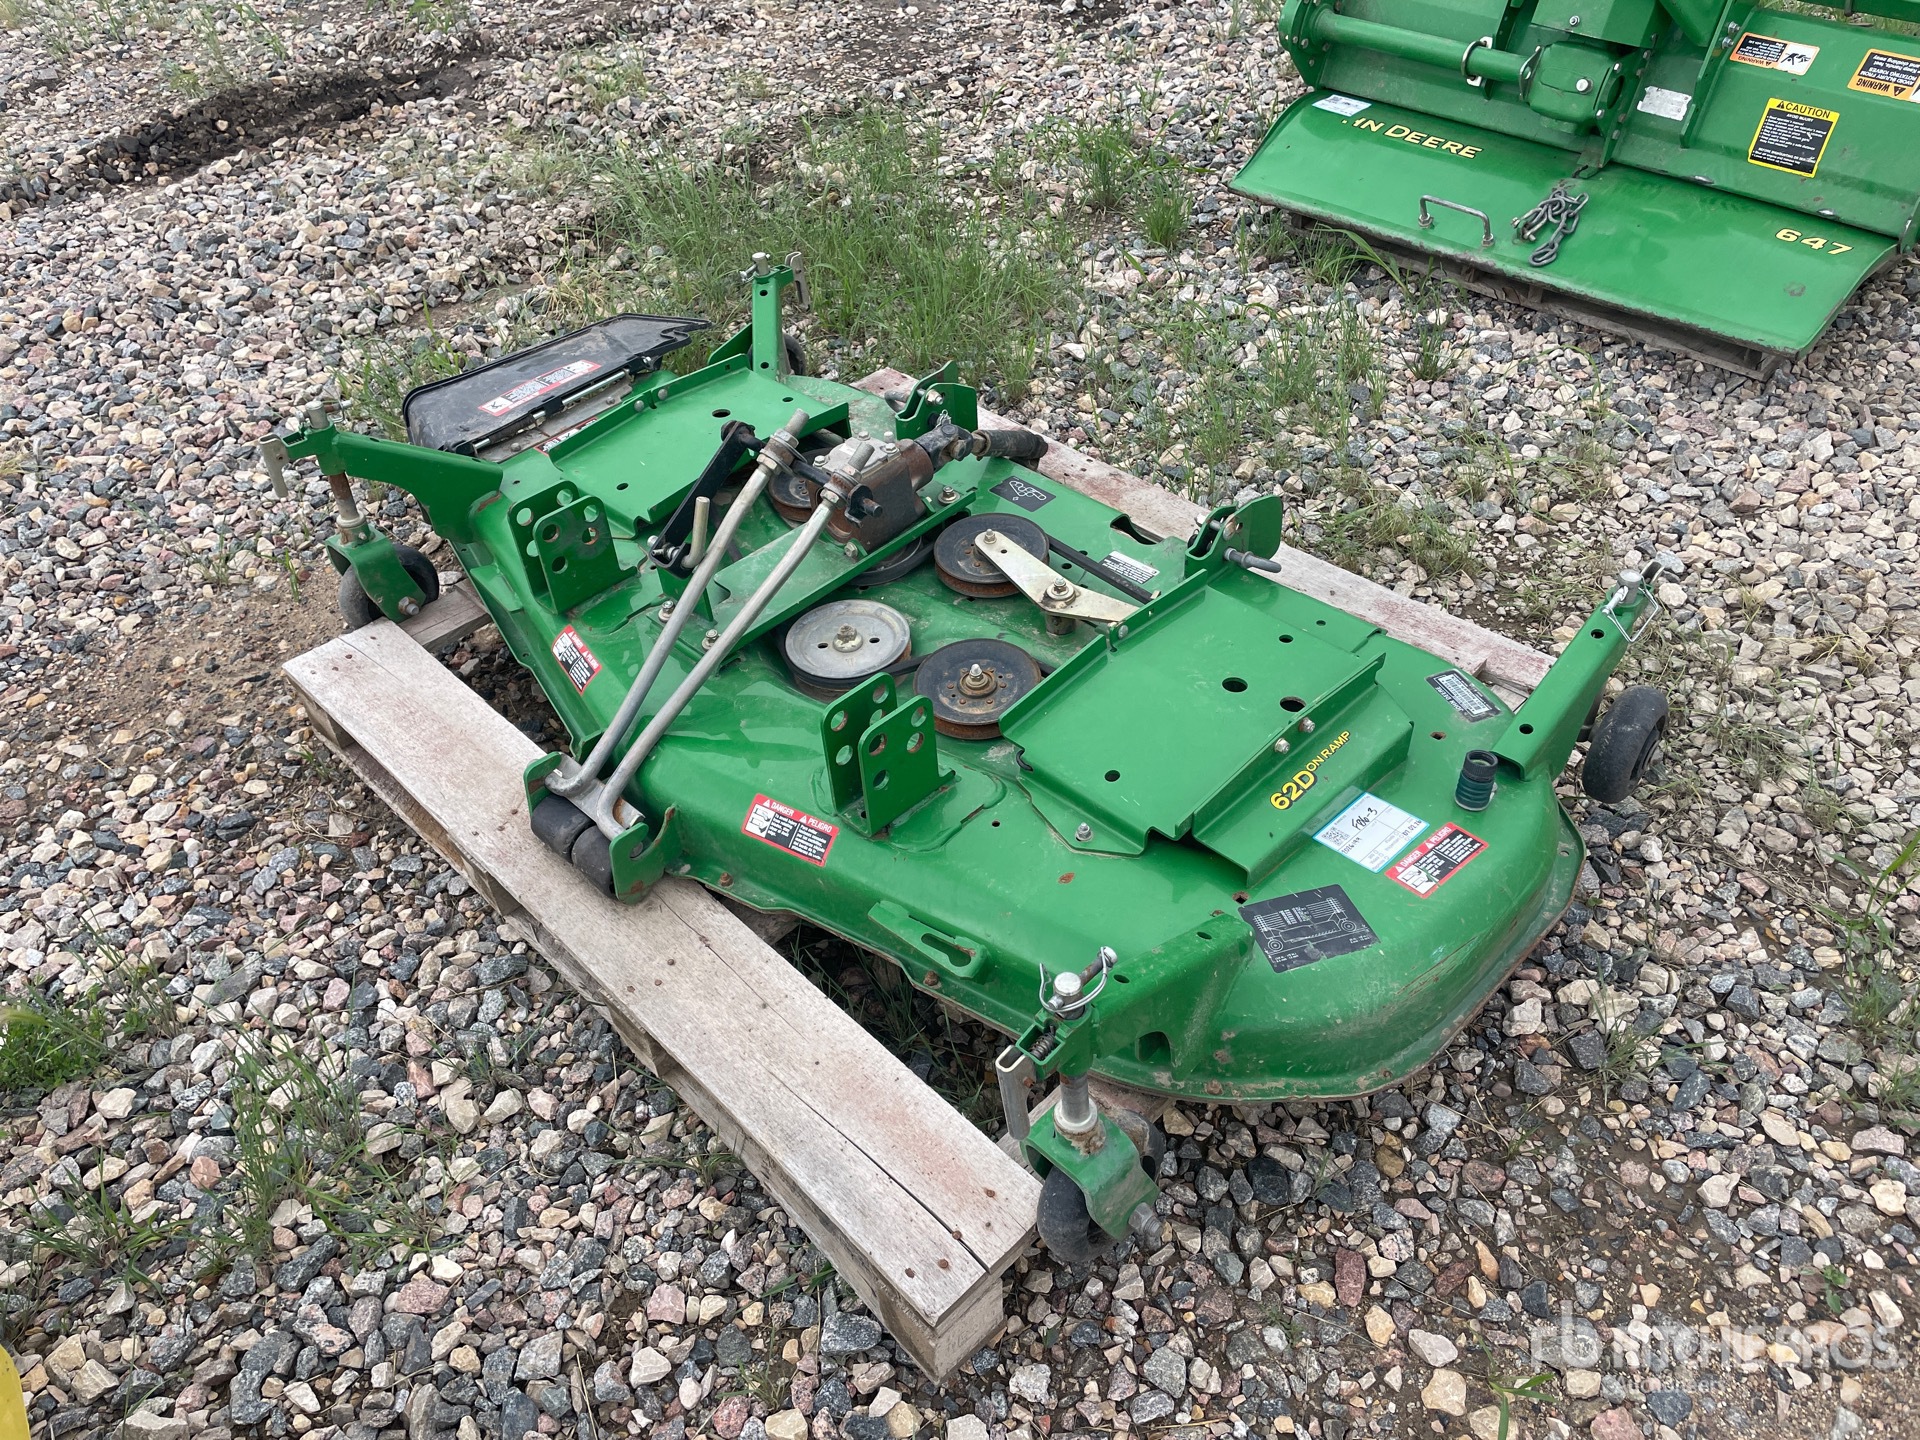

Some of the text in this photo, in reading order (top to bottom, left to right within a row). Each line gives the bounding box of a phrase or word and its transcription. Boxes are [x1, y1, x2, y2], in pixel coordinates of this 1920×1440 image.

[1738, 55, 1765, 65] WARNING
[1868, 67, 1917, 80] ROTATING KNIVES
[1856, 78, 1891, 92] WARNING
[1785, 102, 1831, 119] CAUTION
[1384, 124, 1483, 159] DEERE
[1775, 227, 1854, 255] 647
[1270, 770, 1318, 810] 62D
[1305, 755, 1325, 772] ON
[1320, 730, 1351, 759] RAMP
[770, 801, 795, 817] DANGER
[807, 817, 833, 833] PELIGRO
[1431, 826, 1452, 844] PELIGRO
[1400, 849, 1423, 867] DANGER
